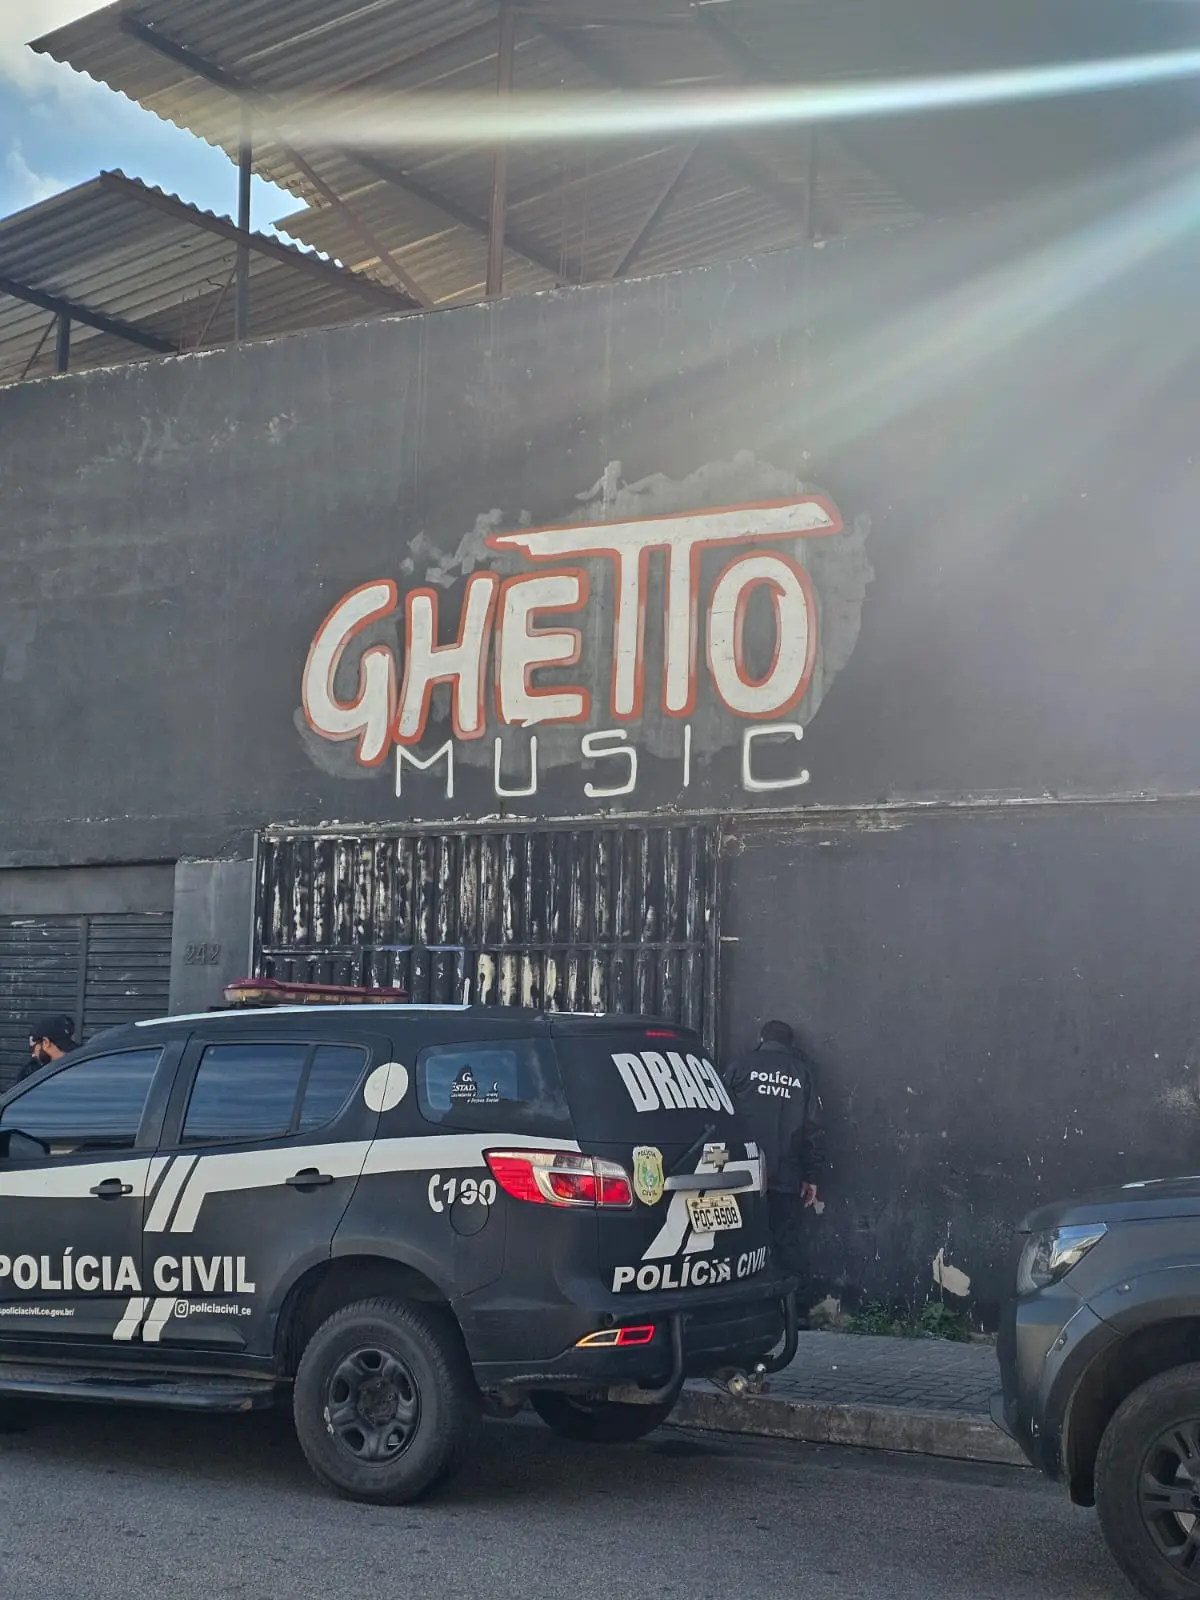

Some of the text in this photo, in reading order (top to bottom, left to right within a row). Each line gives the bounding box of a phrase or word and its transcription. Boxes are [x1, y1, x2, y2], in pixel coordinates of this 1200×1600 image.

[302, 494, 842, 767] GHETTO
[394, 723, 811, 799] MUSIC
[185, 942, 220, 966] 242
[611, 1051, 735, 1116] DRACO
[750, 1070, 802, 1089] POLÍCIA
[757, 1084, 791, 1099] CIVIL
[443, 1177, 497, 1207] 190
[153, 1255, 256, 1293] CIVIL
[611, 1245, 767, 1293] POLÍCIA CIVIL
[189, 1303, 252, 1316] policiacivil_ce
